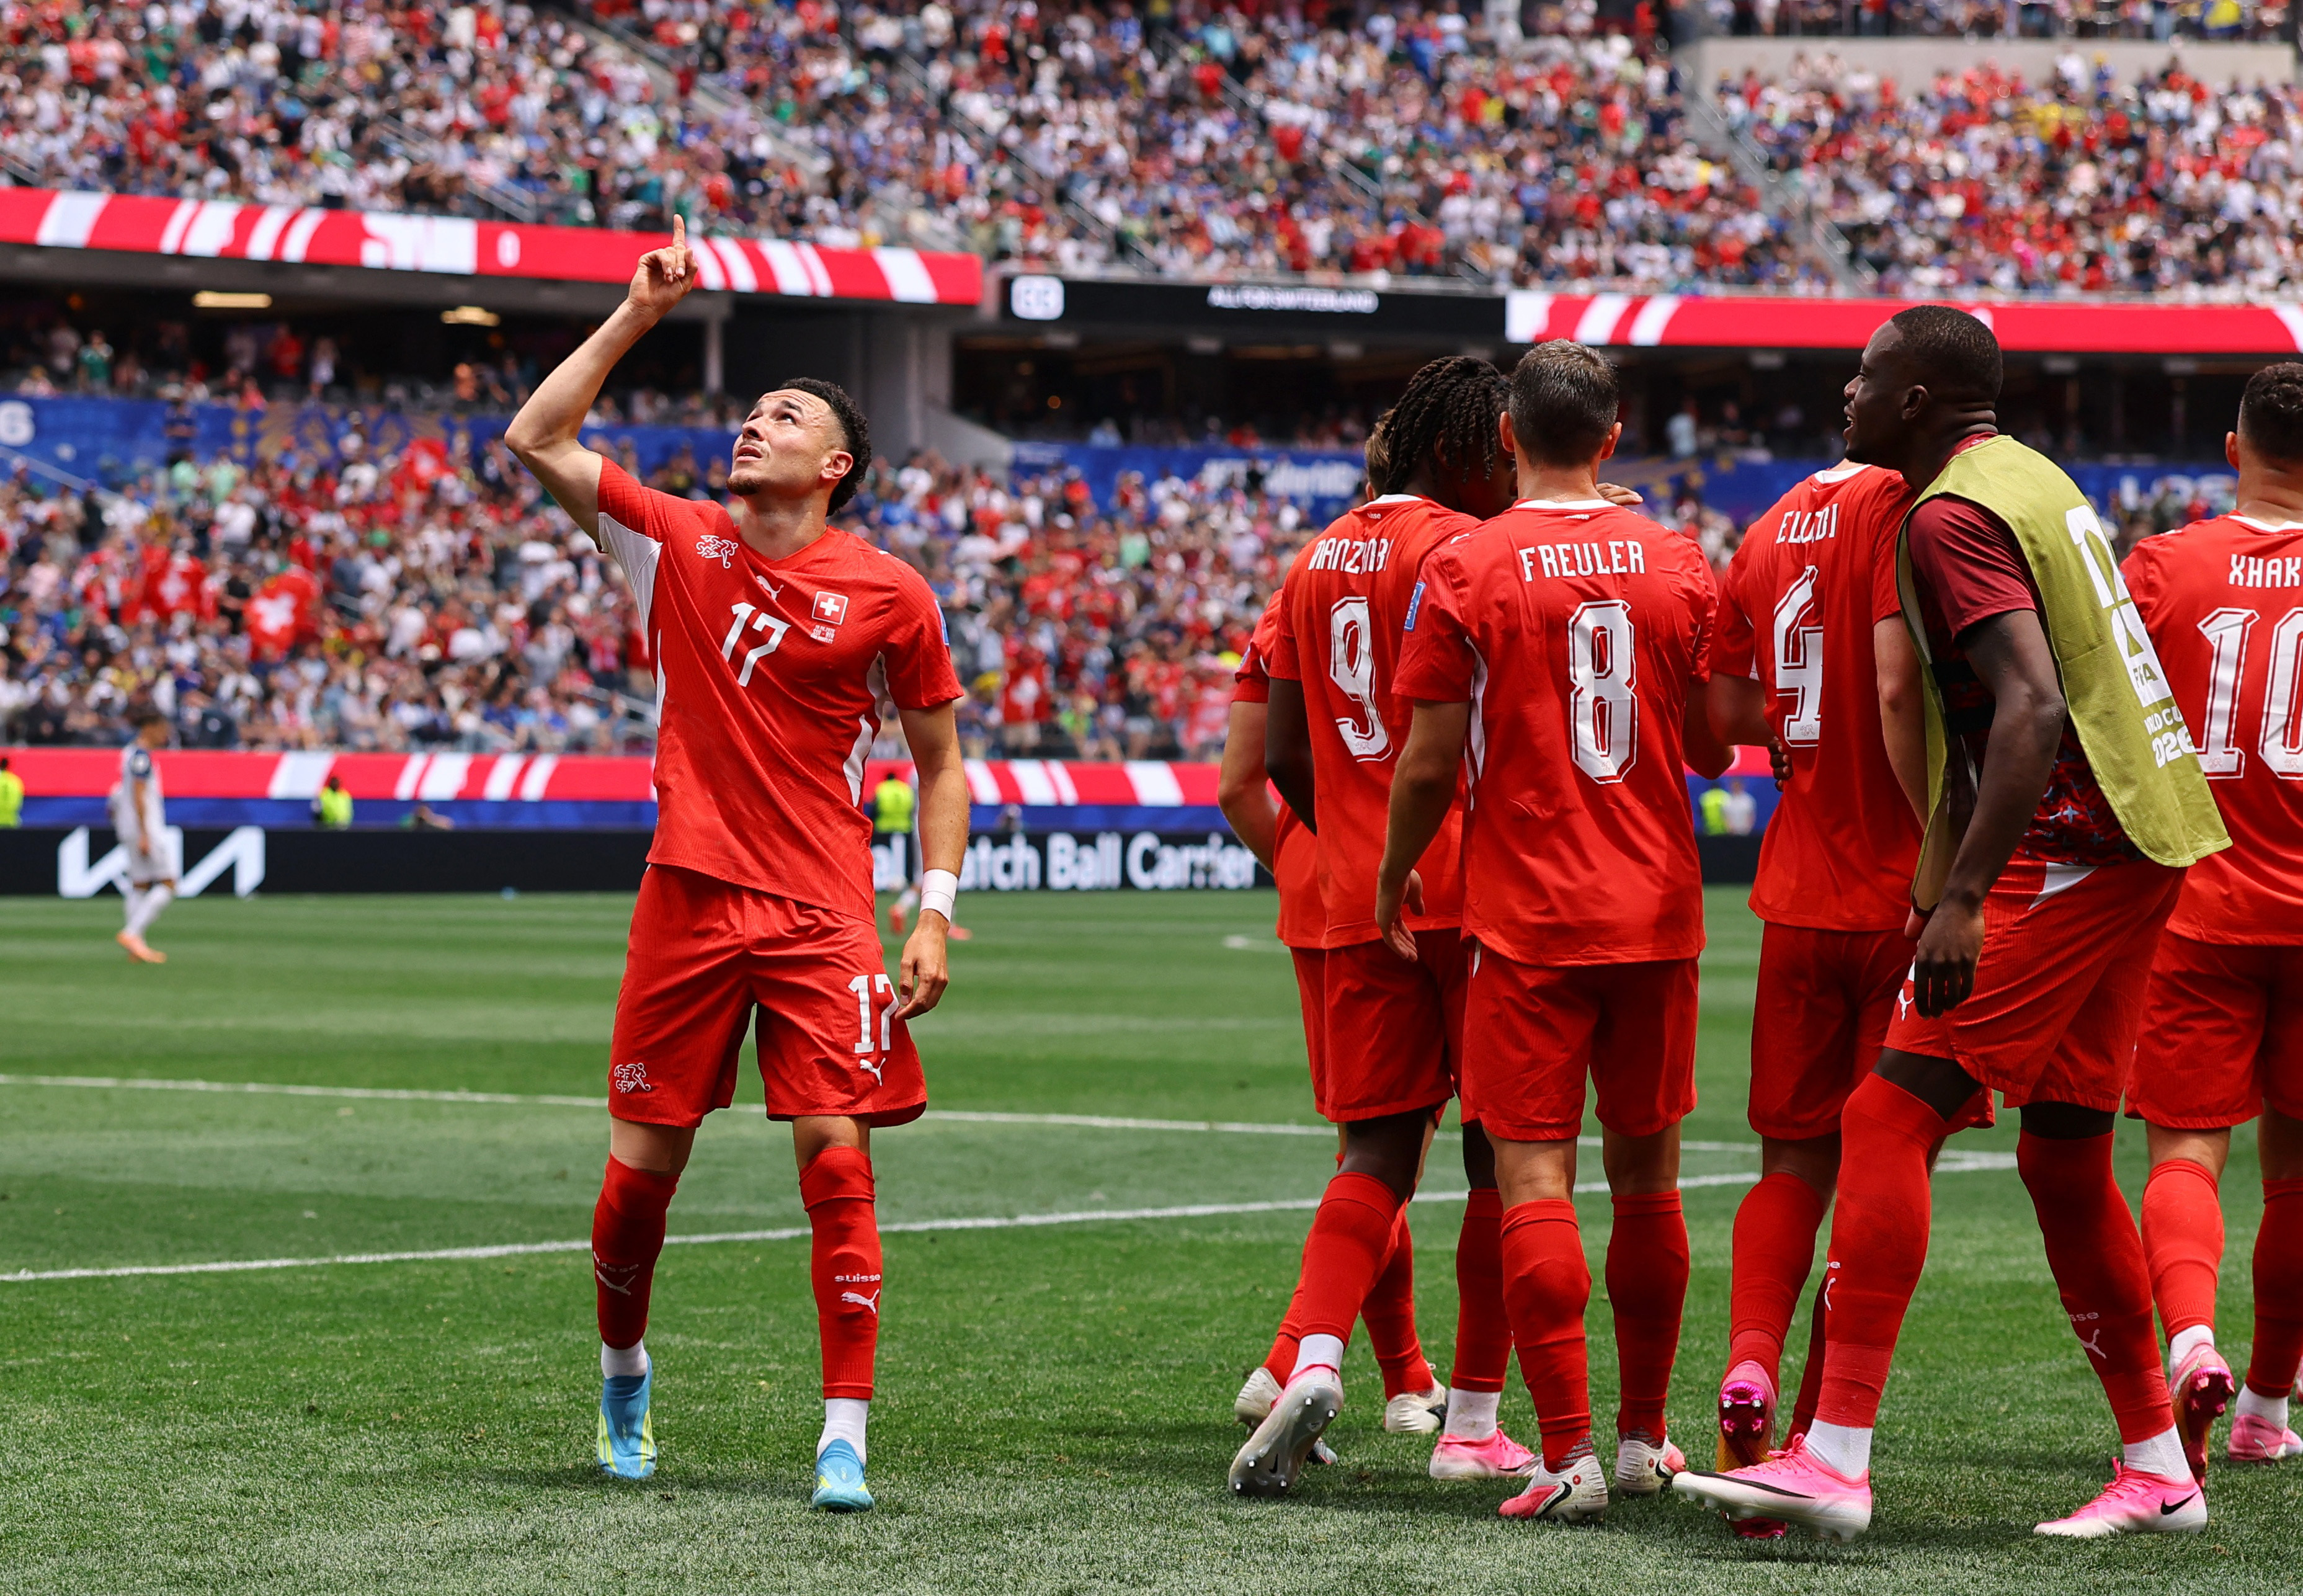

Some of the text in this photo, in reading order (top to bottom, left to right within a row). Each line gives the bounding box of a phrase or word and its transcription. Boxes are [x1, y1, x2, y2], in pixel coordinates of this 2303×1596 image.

[1519, 540, 1645, 582] FREULER
[2229, 553, 2303, 589] XHAK
[721, 602, 792, 687] 17
[1330, 597, 1393, 762] 9
[1774, 565, 1824, 747] 4
[1568, 599, 1637, 785] 8
[2162, 706, 2183, 726] CU
[2196, 607, 2303, 779] 10
[959, 832, 1041, 891] atch
[1047, 832, 1122, 891] Ball
[1126, 830, 1256, 891] Carrier
[847, 973, 900, 1054] 17
[834, 1273, 881, 1282] suisse
